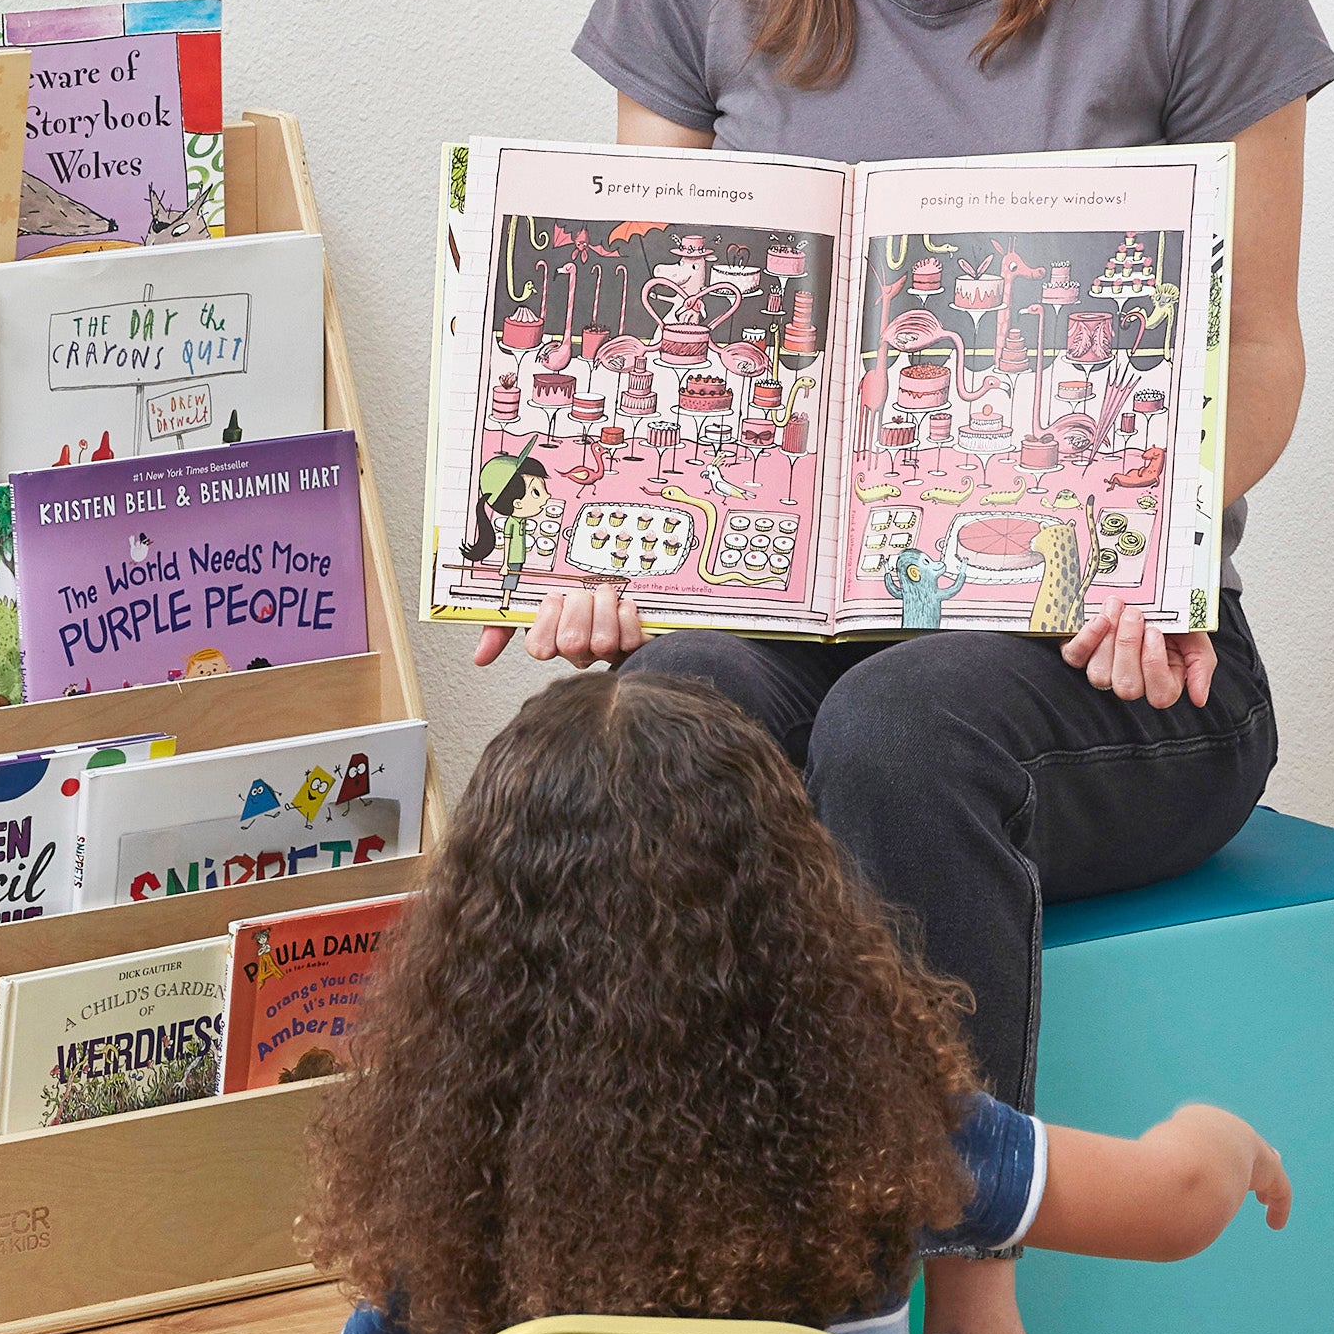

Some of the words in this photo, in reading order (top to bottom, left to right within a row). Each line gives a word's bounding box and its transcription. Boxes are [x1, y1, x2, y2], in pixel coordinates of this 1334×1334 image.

[28, 67, 101, 90] ware
[111, 49, 141, 83] of
[26, 95, 172, 140] Storybook
[47, 149, 143, 185] Wolves
[593, 176, 604, 194] 5
[607, 182, 651, 198] pretty
[655, 182, 684, 198] pink
[688, 184, 755, 203] flamingos
[921, 194, 964, 209] posing
[969, 192, 980, 205] in
[985, 192, 1006, 205] the
[1011, 192, 1058, 209] bakery
[1063, 192, 1127, 206] windows!
[73, 315, 111, 338] THE
[129, 308, 180, 341] DAY
[200, 302, 226, 331] the
[52, 340, 165, 370] CRAYONS
[182, 337, 243, 375] QUIT
[170, 393, 206, 413] DREW
[133, 473, 144, 483] #1
[146, 471, 165, 482] New
[167, 468, 184, 479] York
[185, 465, 210, 476] Times
[210, 460, 250, 473] Bestseller
[39, 494, 117, 525] KRISTEN
[126, 488, 167, 514] BELL
[176, 485, 191, 508] &
[200, 471, 291, 504] BENJAMIN
[299, 465, 341, 490] HART
[58, 581, 99, 616] The
[105, 550, 181, 596] World
[188, 542, 264, 576] Needs
[271, 540, 333, 578] More
[58, 588, 193, 668] PURPLE
[204, 584, 337, 631] PEOPLE
[119, 969, 141, 981] DICK
[142, 961, 182, 975] GAUTIER
[243, 938, 317, 990] PAULA
[324, 931, 381, 957] DANZ
[64, 1017, 77, 1032] A
[81, 986, 150, 1020] CHILD'S
[154, 981, 224, 1000] GARDEN
[139, 1005, 155, 1017] OF
[266, 982, 318, 1018] Orange
[320, 976, 346, 988] You
[303, 997, 325, 1014] It's
[329, 992, 359, 1005] Hall
[257, 1017, 328, 1062] Amber
